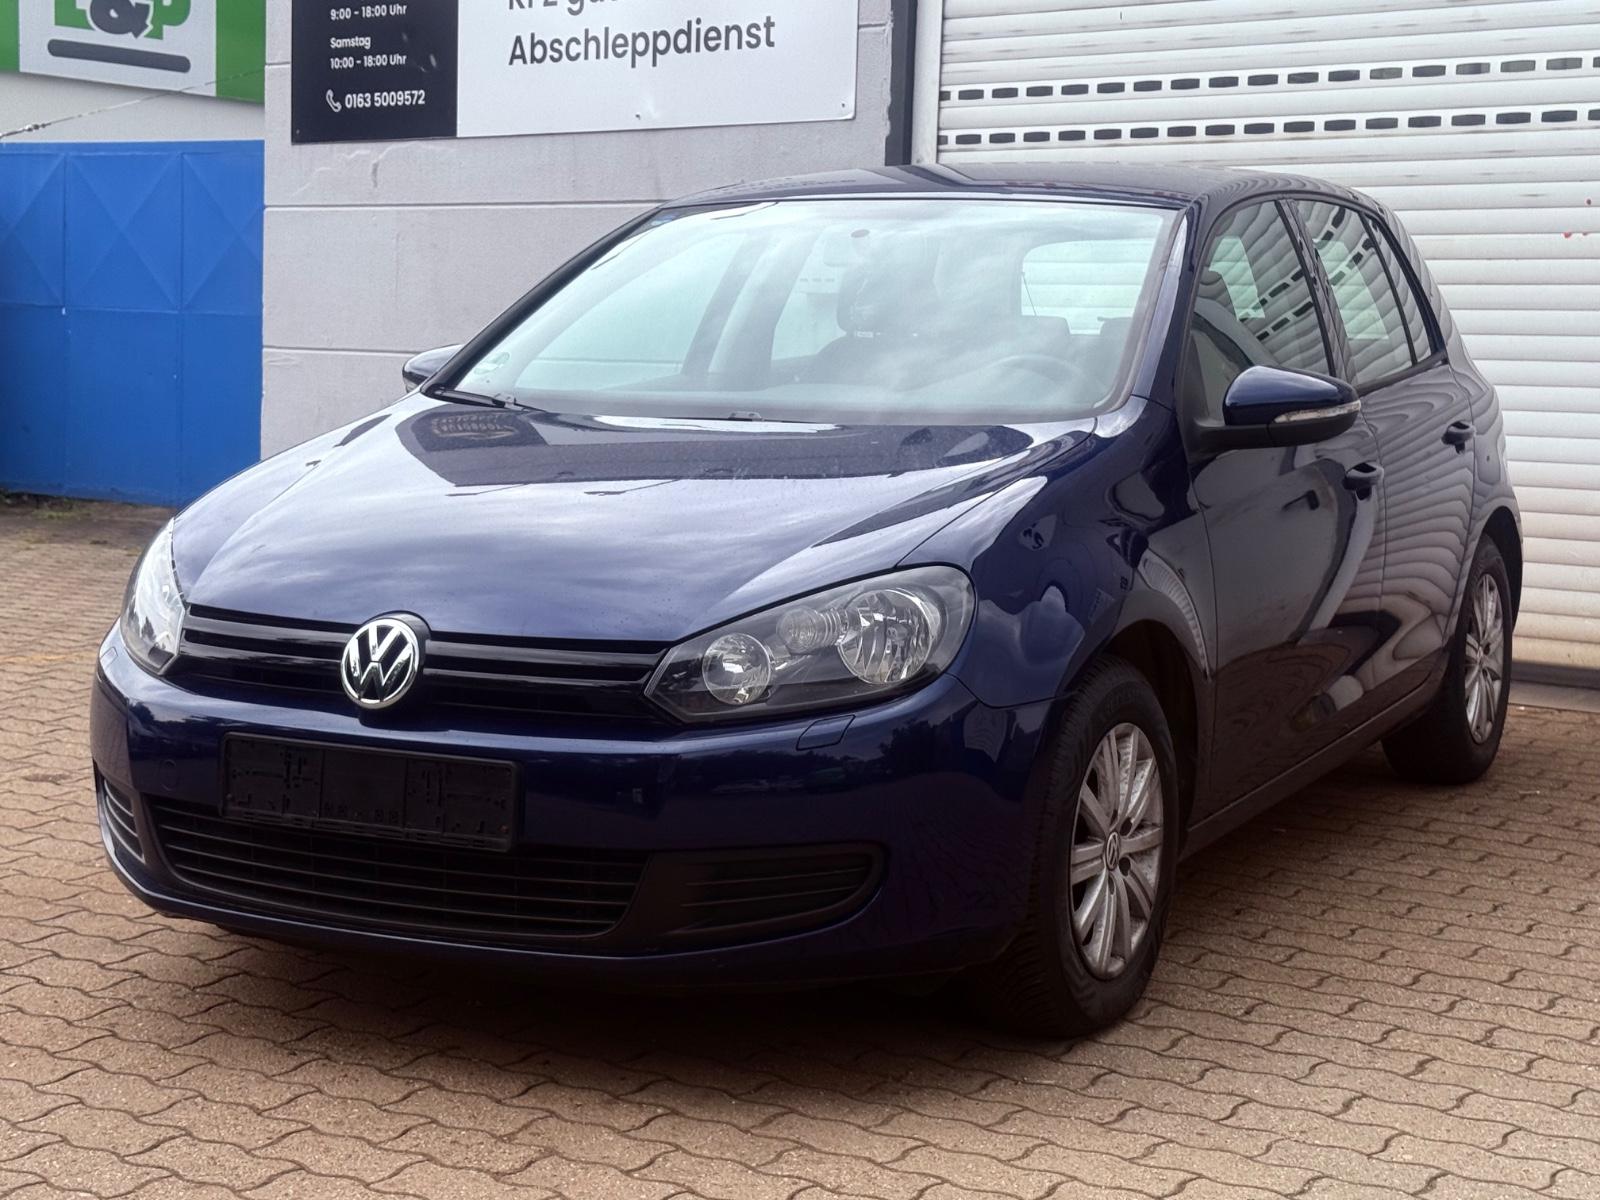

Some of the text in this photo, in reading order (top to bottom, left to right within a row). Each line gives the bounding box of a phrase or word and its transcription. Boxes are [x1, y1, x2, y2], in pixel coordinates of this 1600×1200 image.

[330, 8, 352, 20] 9:00
[361, 4, 388, 18] 18:00
[389, 3, 407, 16] Uhr
[330, 36, 371, 49] Samstag
[508, 16, 776, 68] Abschleppdienst
[330, 57, 354, 69] 10:00
[363, 55, 388, 67] 18:00
[389, 53, 407, 65] Uhr
[345, 89, 426, 109] 0163 5009572
[343, 620, 417, 706] VW
